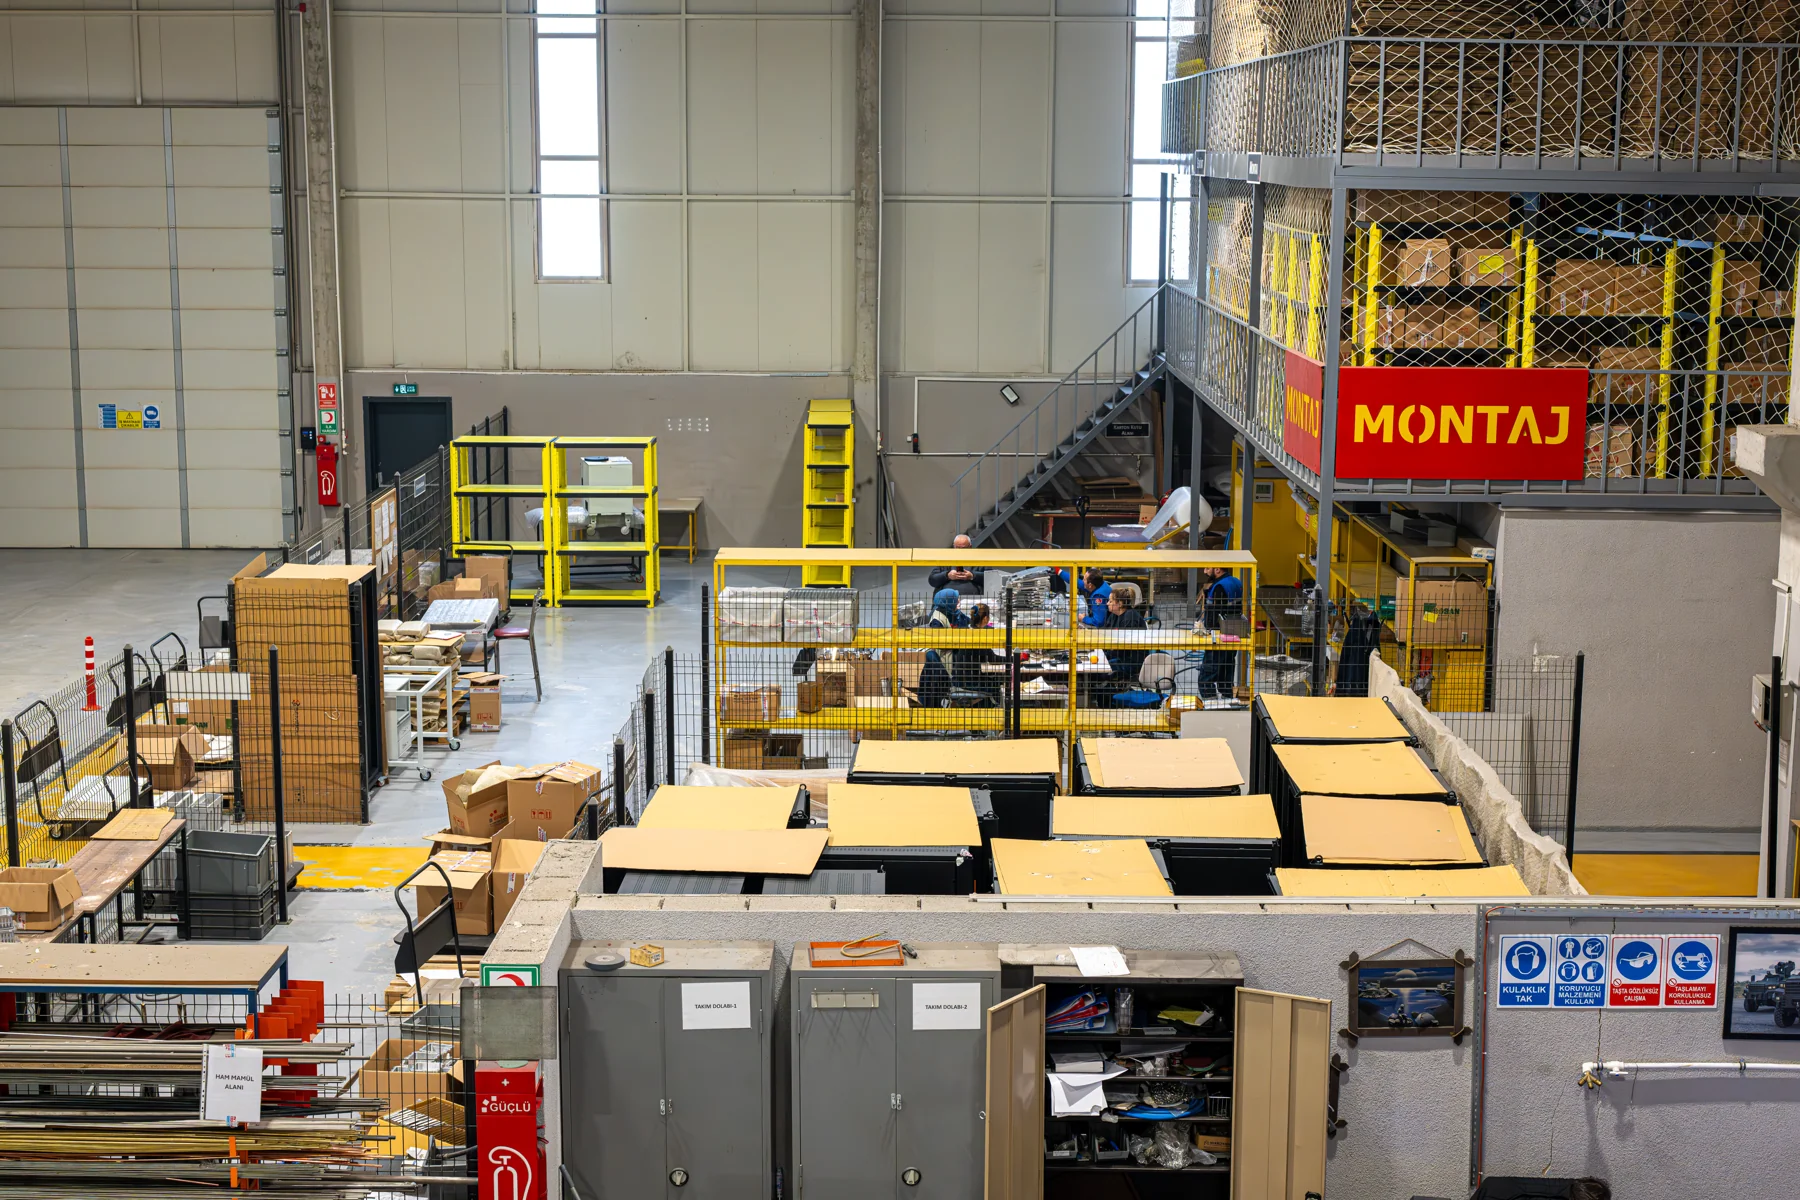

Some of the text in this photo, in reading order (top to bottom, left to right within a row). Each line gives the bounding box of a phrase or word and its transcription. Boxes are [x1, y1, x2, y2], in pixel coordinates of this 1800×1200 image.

[1286, 384, 1319, 438] MONTAJ
[1354, 404, 1570, 445] MONTAJ
[1502, 986, 1546, 994] KULAKLIK
[490, 1101, 531, 1114] GÜÇLÜ
